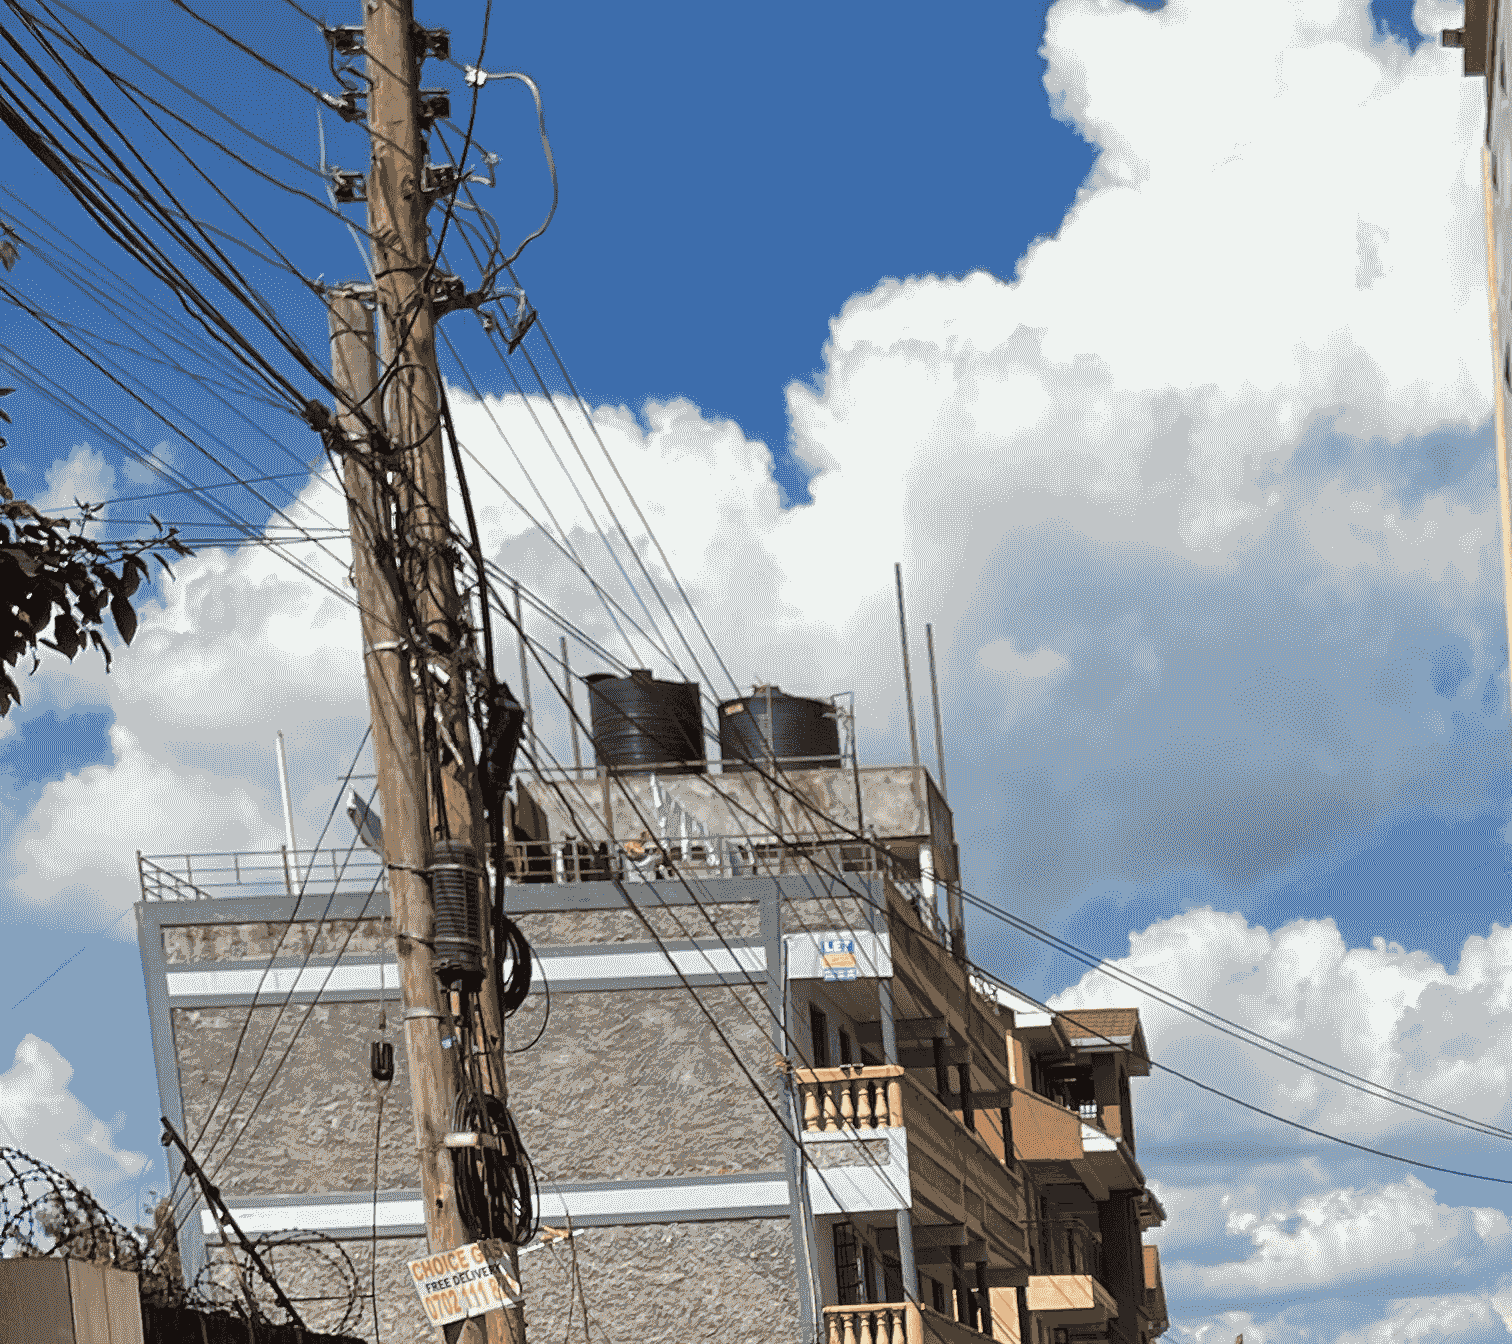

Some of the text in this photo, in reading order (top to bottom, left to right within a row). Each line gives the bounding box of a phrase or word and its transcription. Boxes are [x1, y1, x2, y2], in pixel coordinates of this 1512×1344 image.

[411, 1249, 469, 1281] CHOICE
[425, 1277, 451, 1293] FREE
[424, 1289, 462, 1320] 0702
